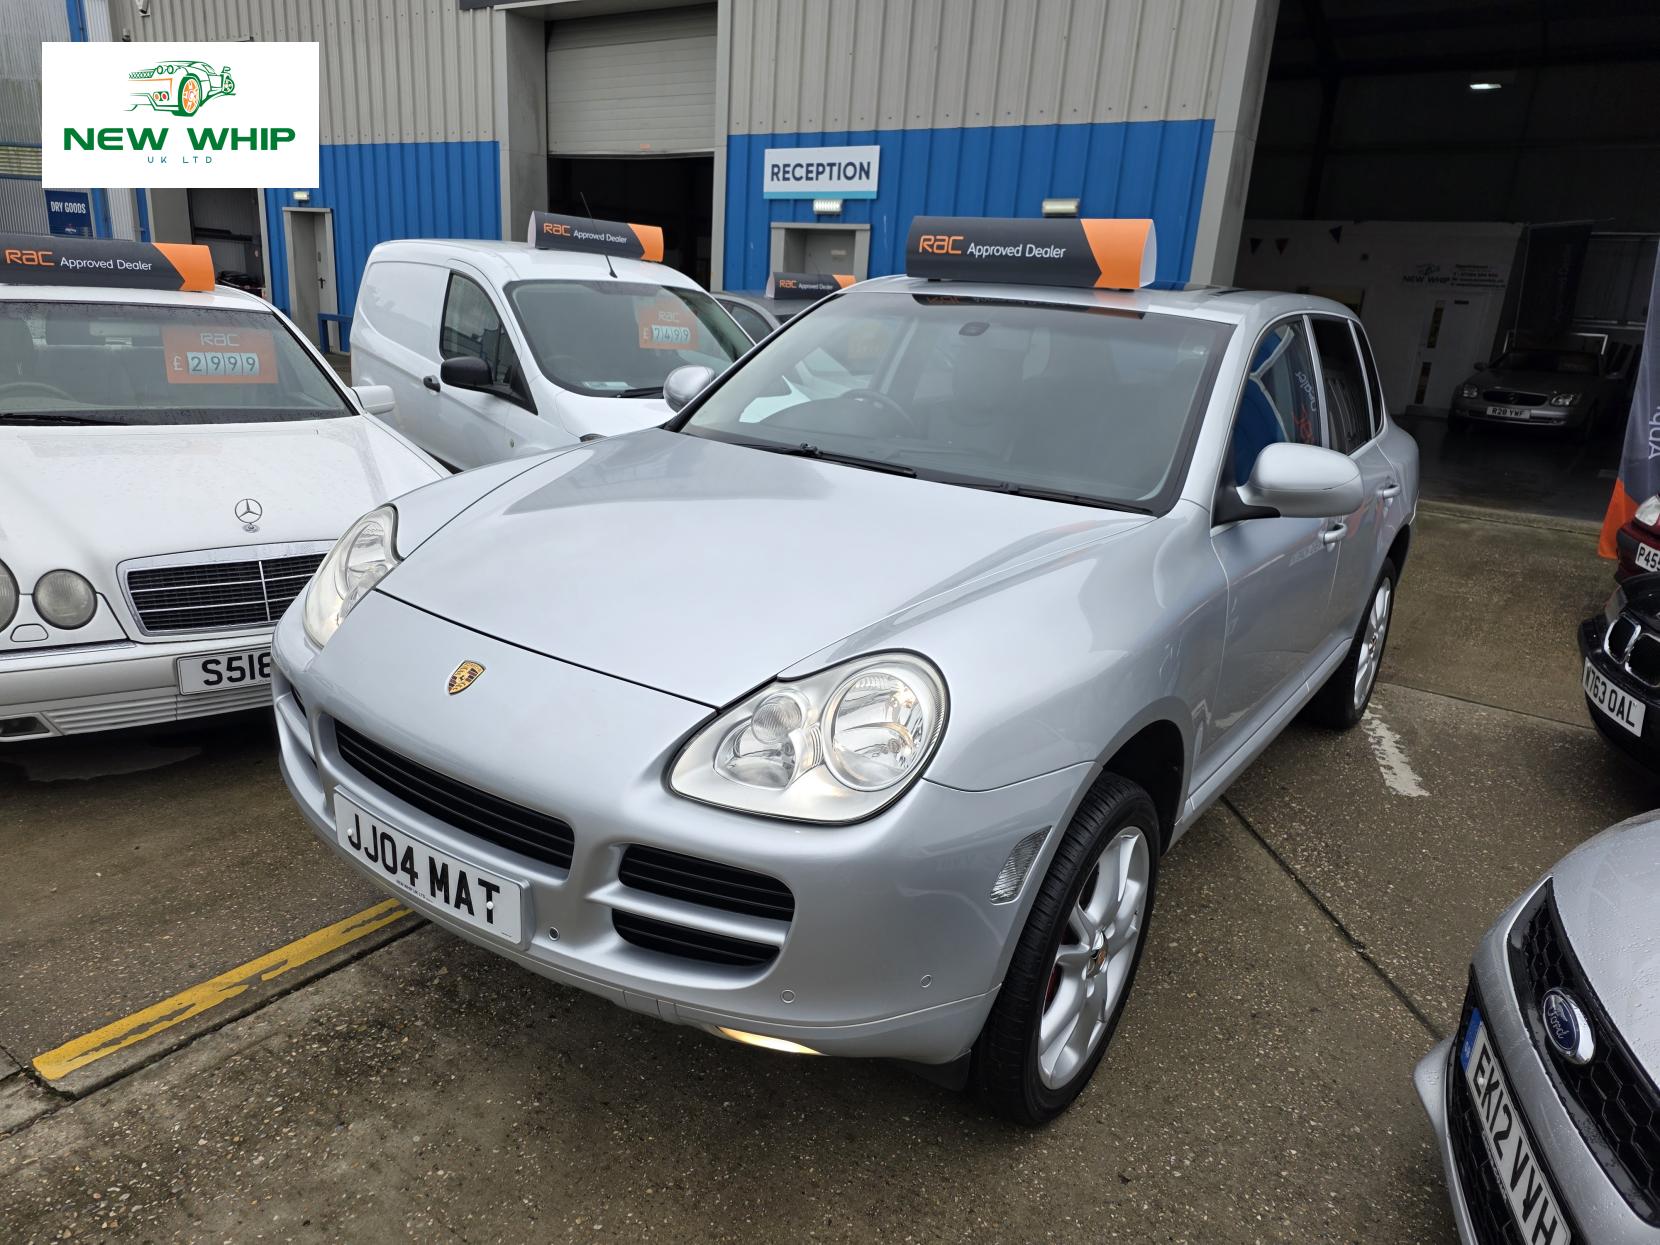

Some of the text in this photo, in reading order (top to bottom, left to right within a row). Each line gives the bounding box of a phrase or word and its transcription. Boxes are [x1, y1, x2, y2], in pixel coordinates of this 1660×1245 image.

[771, 160, 871, 183] RECEPTION
[50, 200, 87, 215] DRY GOODS
[573, 229, 604, 241] Approved
[606, 233, 628, 244] Dealer
[967, 242, 1022, 259] Approved
[1026, 243, 1067, 259] Dealer
[60, 256, 114, 270] Approved
[116, 258, 152, 271] Dealer
[654, 327, 689, 342] 7499
[191, 356, 256, 372] 2999
[347, 813, 501, 924] JJ04 MAT
[1547, 1003, 1569, 1039] Ford
[1473, 1042, 1512, 1161] EK12
